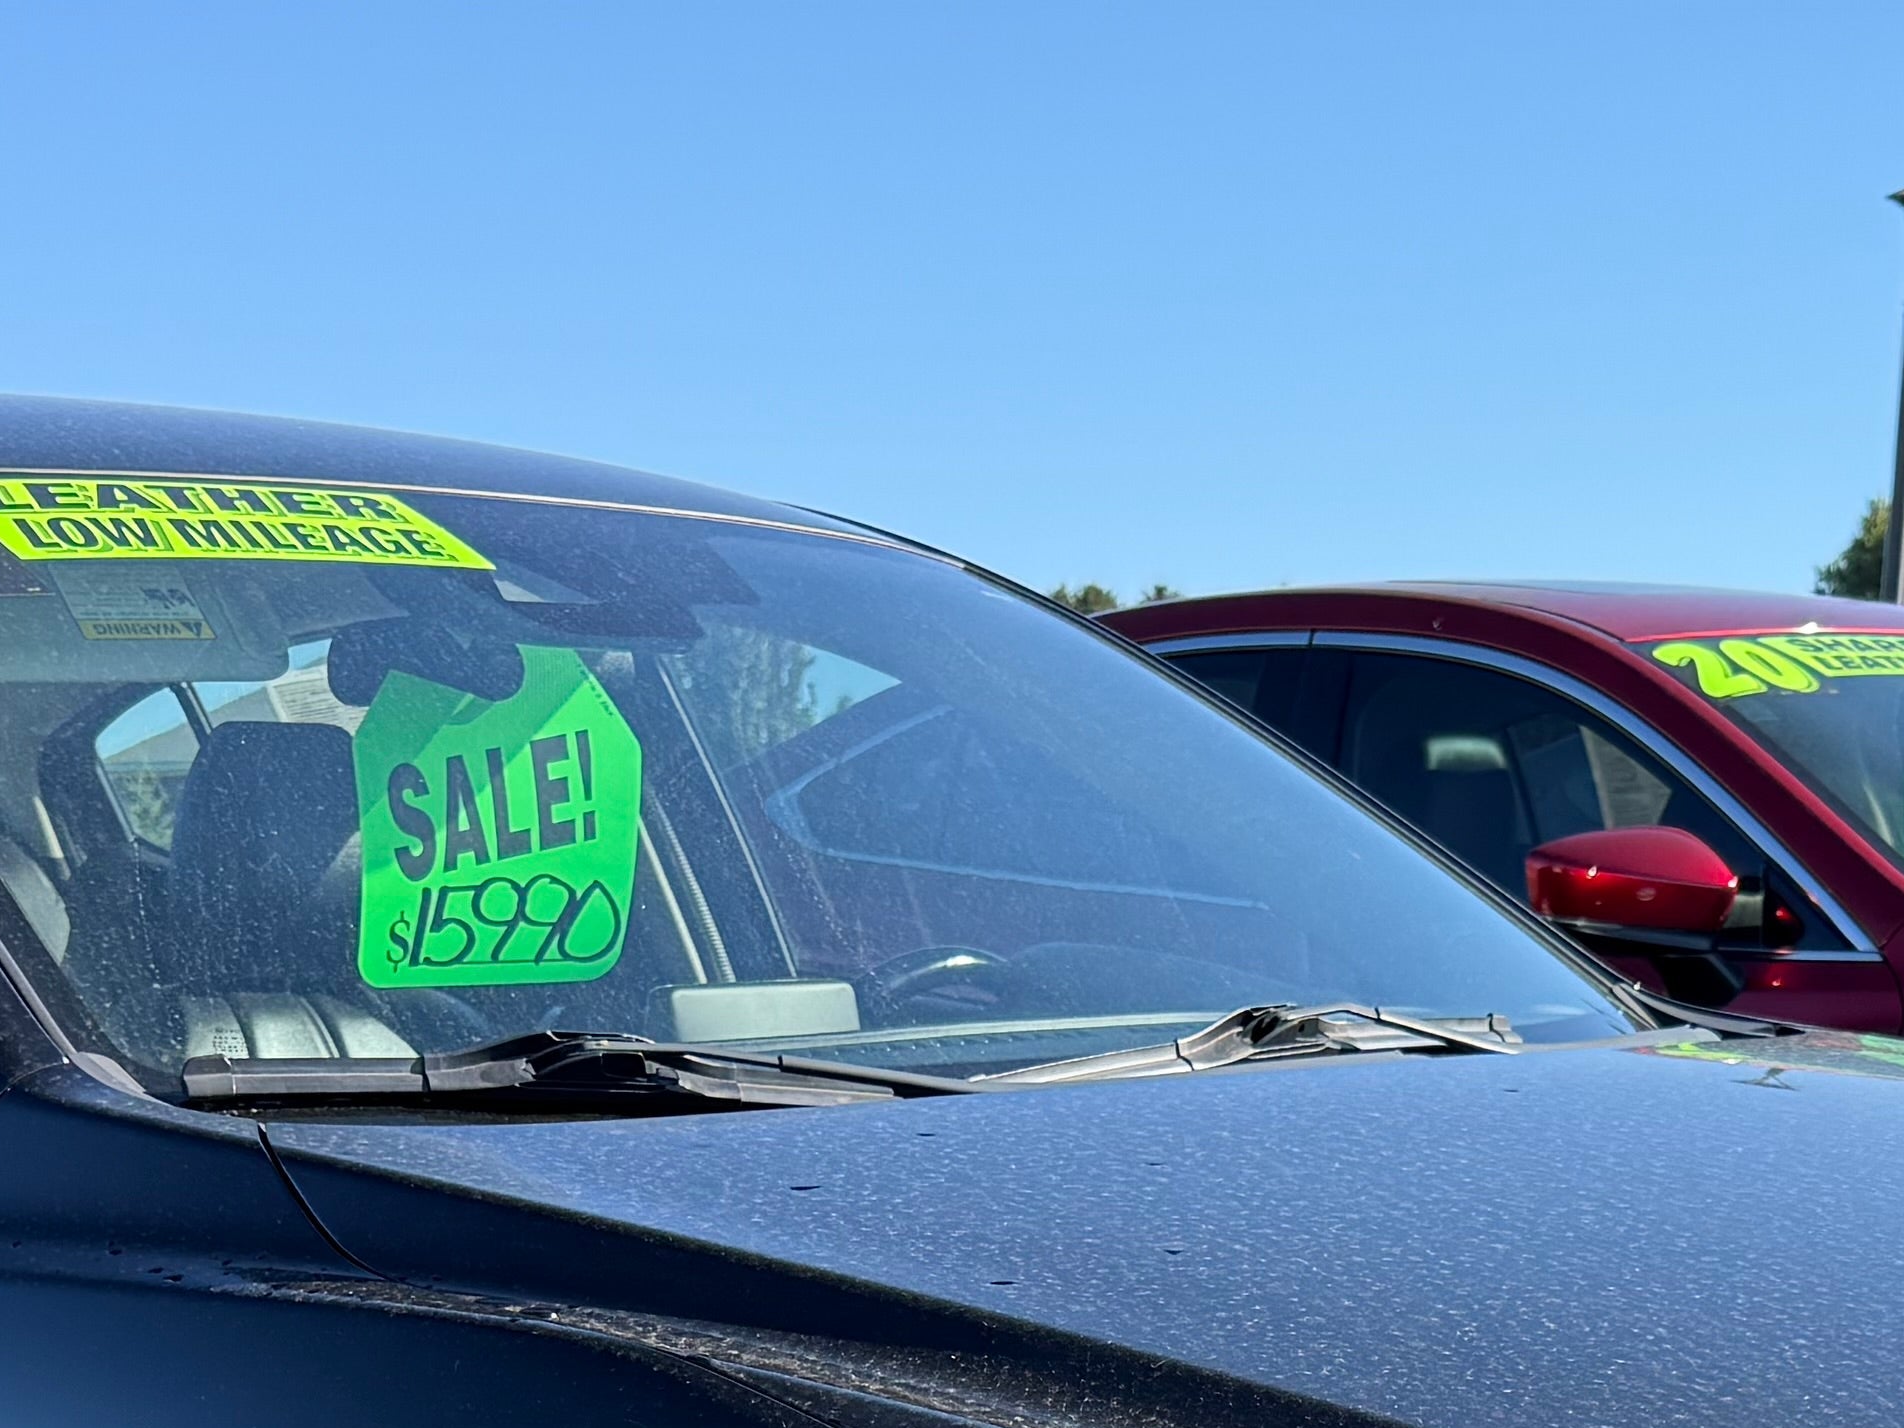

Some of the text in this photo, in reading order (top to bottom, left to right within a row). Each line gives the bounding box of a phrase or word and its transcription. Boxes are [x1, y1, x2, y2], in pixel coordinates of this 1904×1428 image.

[12, 517, 448, 560] LOW MILEAGE
[91, 621, 183, 637] WARNING
[1652, 638, 1820, 699] 20
[387, 727, 597, 882] SALE!
[386, 873, 622, 974] $15990
